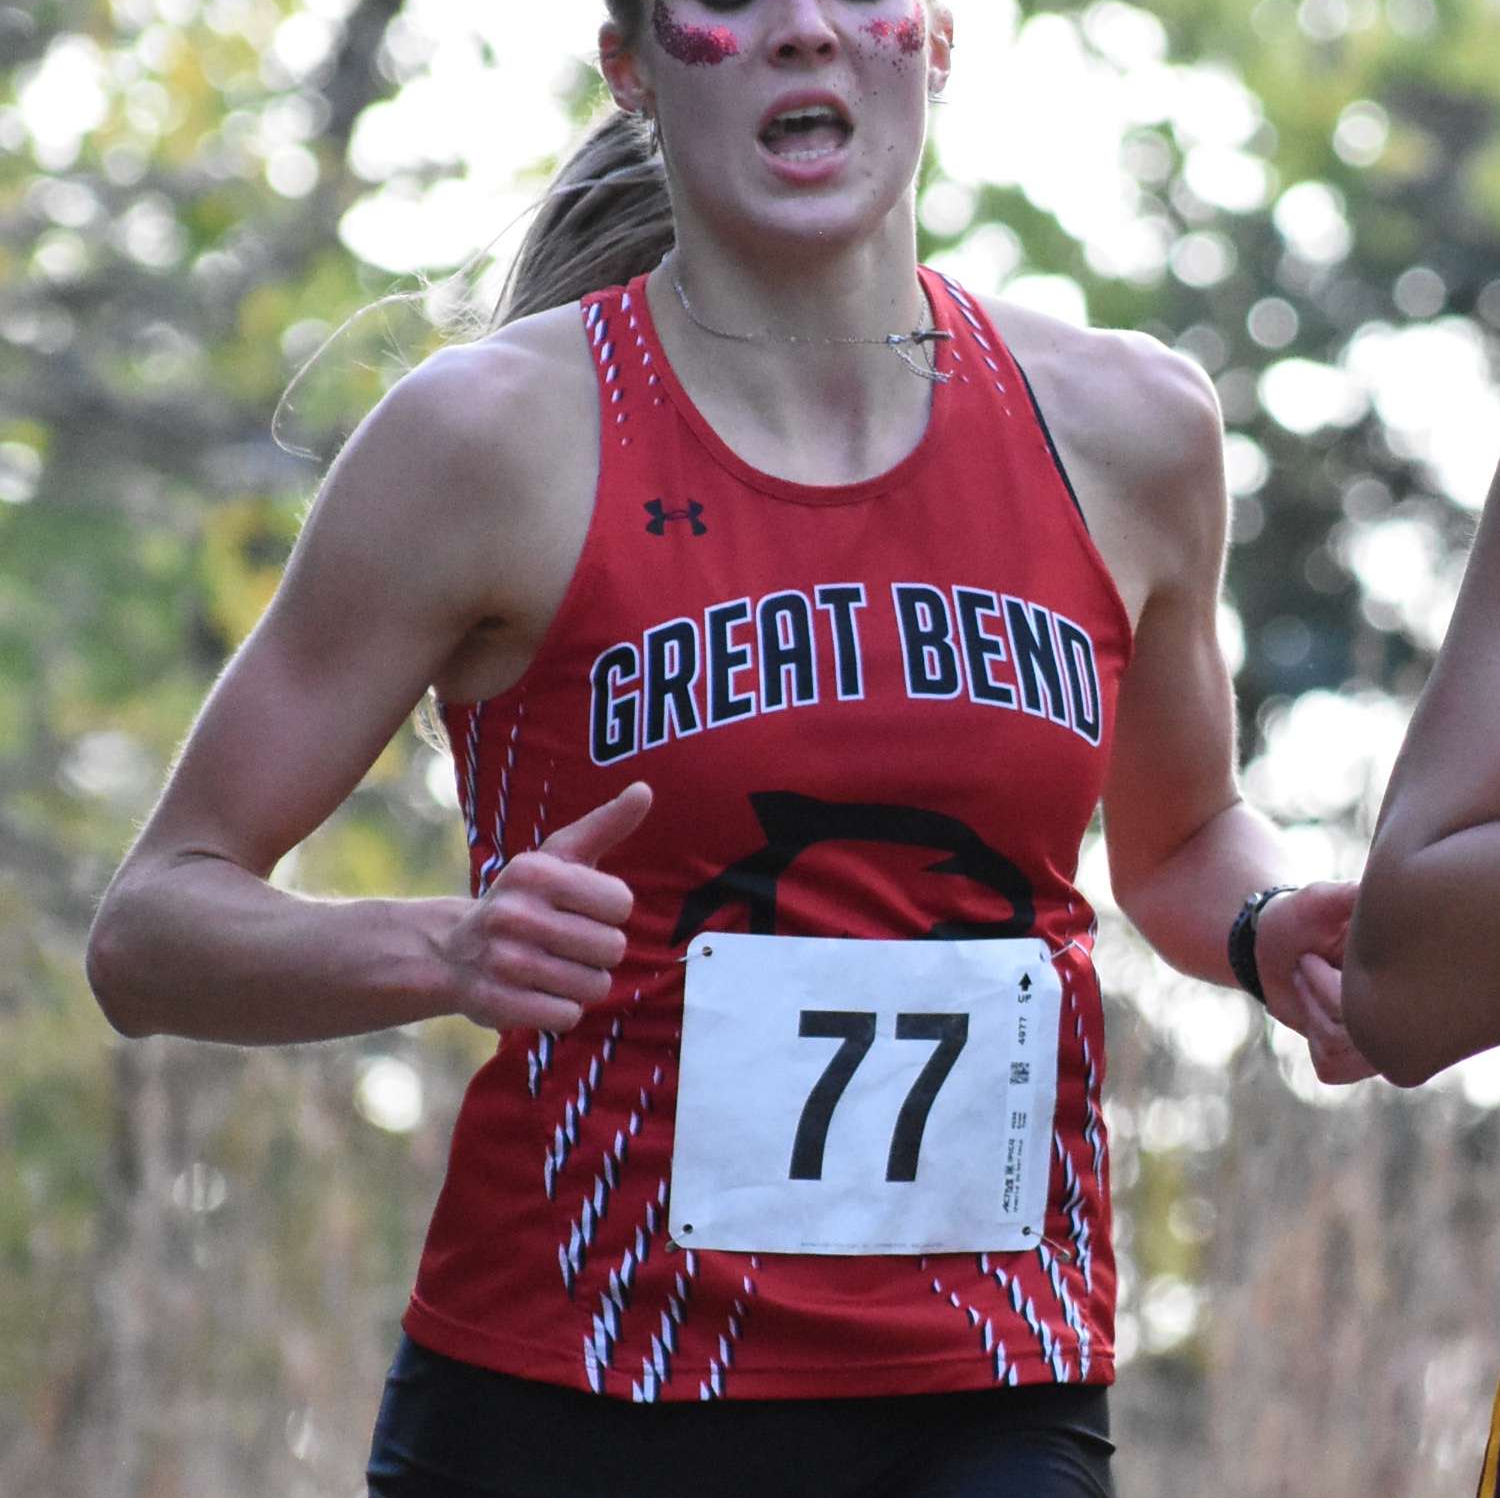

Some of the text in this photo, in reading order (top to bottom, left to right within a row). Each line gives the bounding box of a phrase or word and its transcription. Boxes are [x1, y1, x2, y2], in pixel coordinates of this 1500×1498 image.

[589, 582, 1103, 767] GREAT BEND
[788, 1009, 970, 1183] 77
